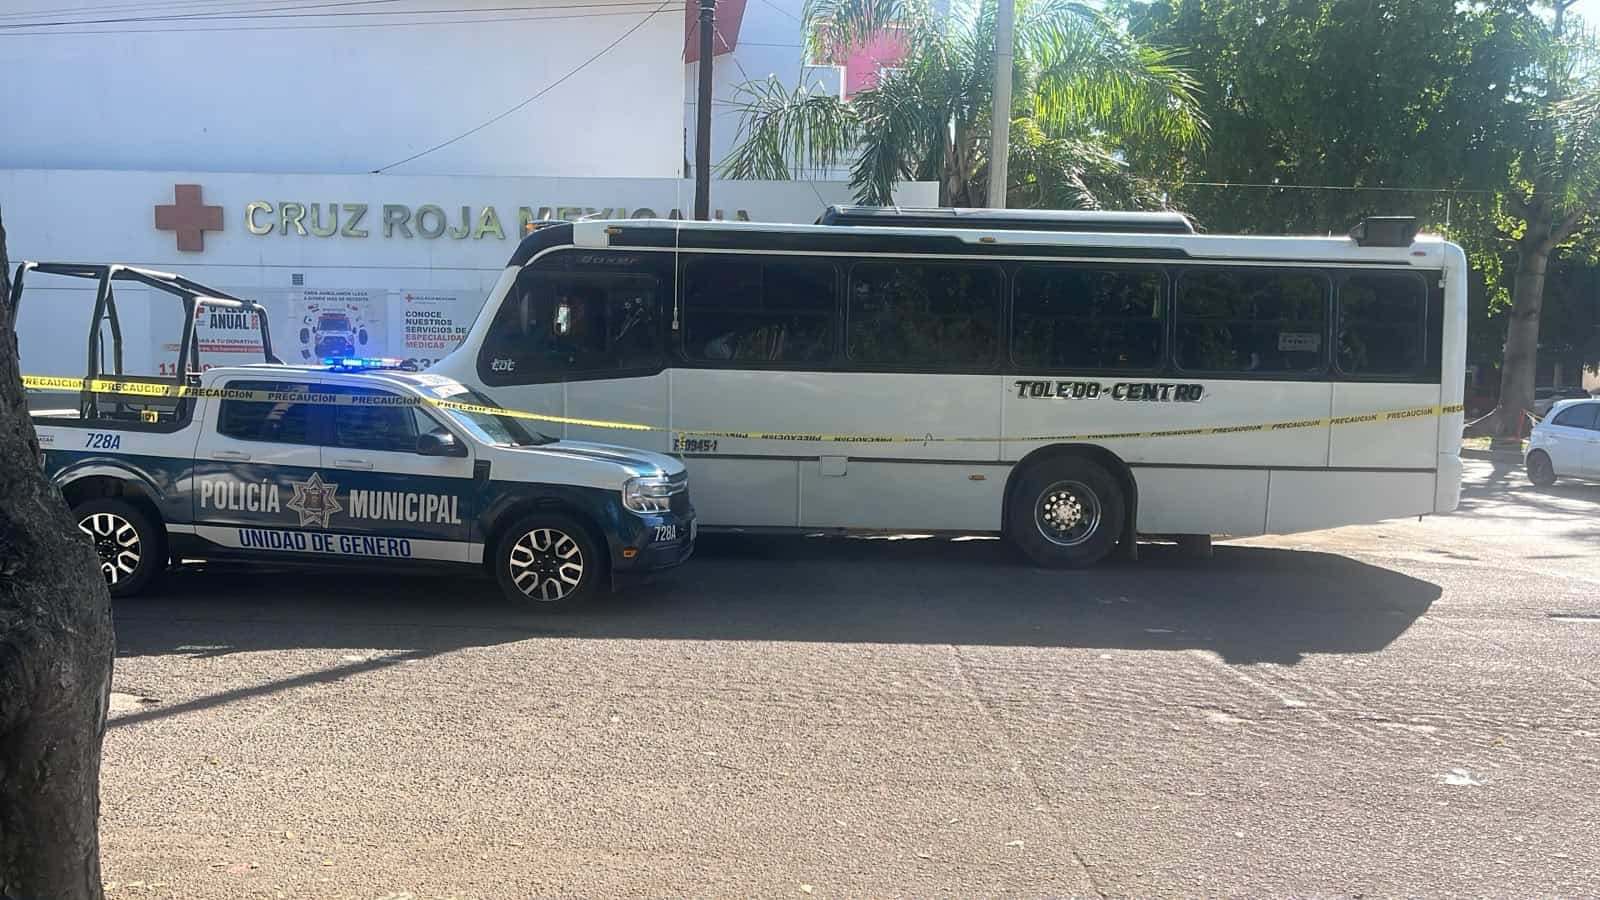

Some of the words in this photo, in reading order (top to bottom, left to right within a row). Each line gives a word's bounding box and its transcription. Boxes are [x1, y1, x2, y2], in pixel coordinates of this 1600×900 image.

[245, 200, 369, 239] CRUZ
[383, 203, 505, 241] ROJA
[210, 314, 250, 330] ANUAL
[405, 318, 453, 326] NUESTROS
[405, 326, 453, 334] SERVICIOS
[1014, 380, 1205, 403] TOLEDO-CENTRO
[85, 432, 122, 450] 728A
[200, 477, 281, 513] POLICÍA
[349, 489, 462, 525] MUNICIPAL
[655, 524, 677, 542] 728A
[238, 528, 307, 551] UNIDAD
[312, 532, 336, 552] DE
[339, 535, 412, 557] GENERO
